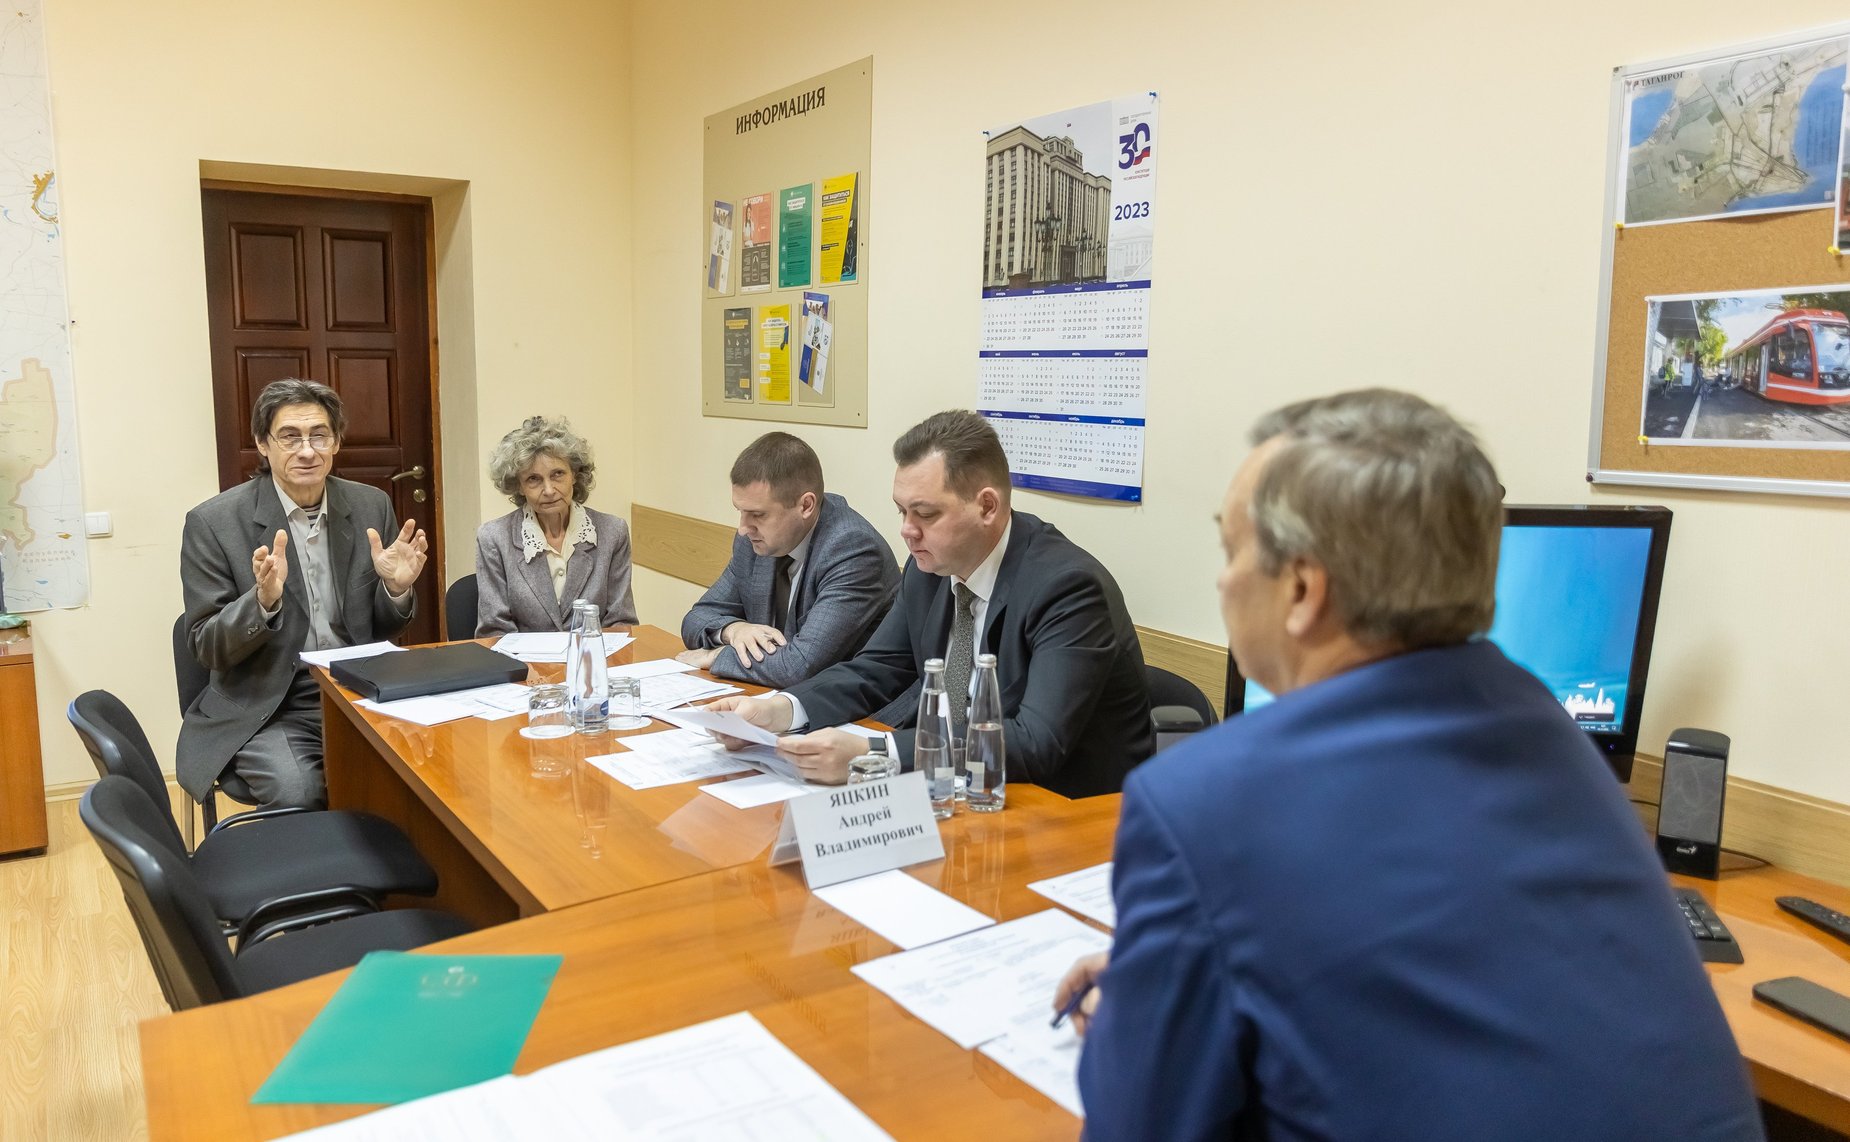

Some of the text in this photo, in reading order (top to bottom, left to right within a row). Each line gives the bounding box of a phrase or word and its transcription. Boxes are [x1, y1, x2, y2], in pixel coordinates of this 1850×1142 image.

[735, 86, 826, 135] ИНФОРМАЦИЯ
[1118, 122, 1151, 170] 30
[1114, 201, 1150, 221] 2023
[830, 783, 890, 808] ЯЦКИН
[839, 806, 892, 830] Андрей
[815, 823, 924, 858] Владимирович
